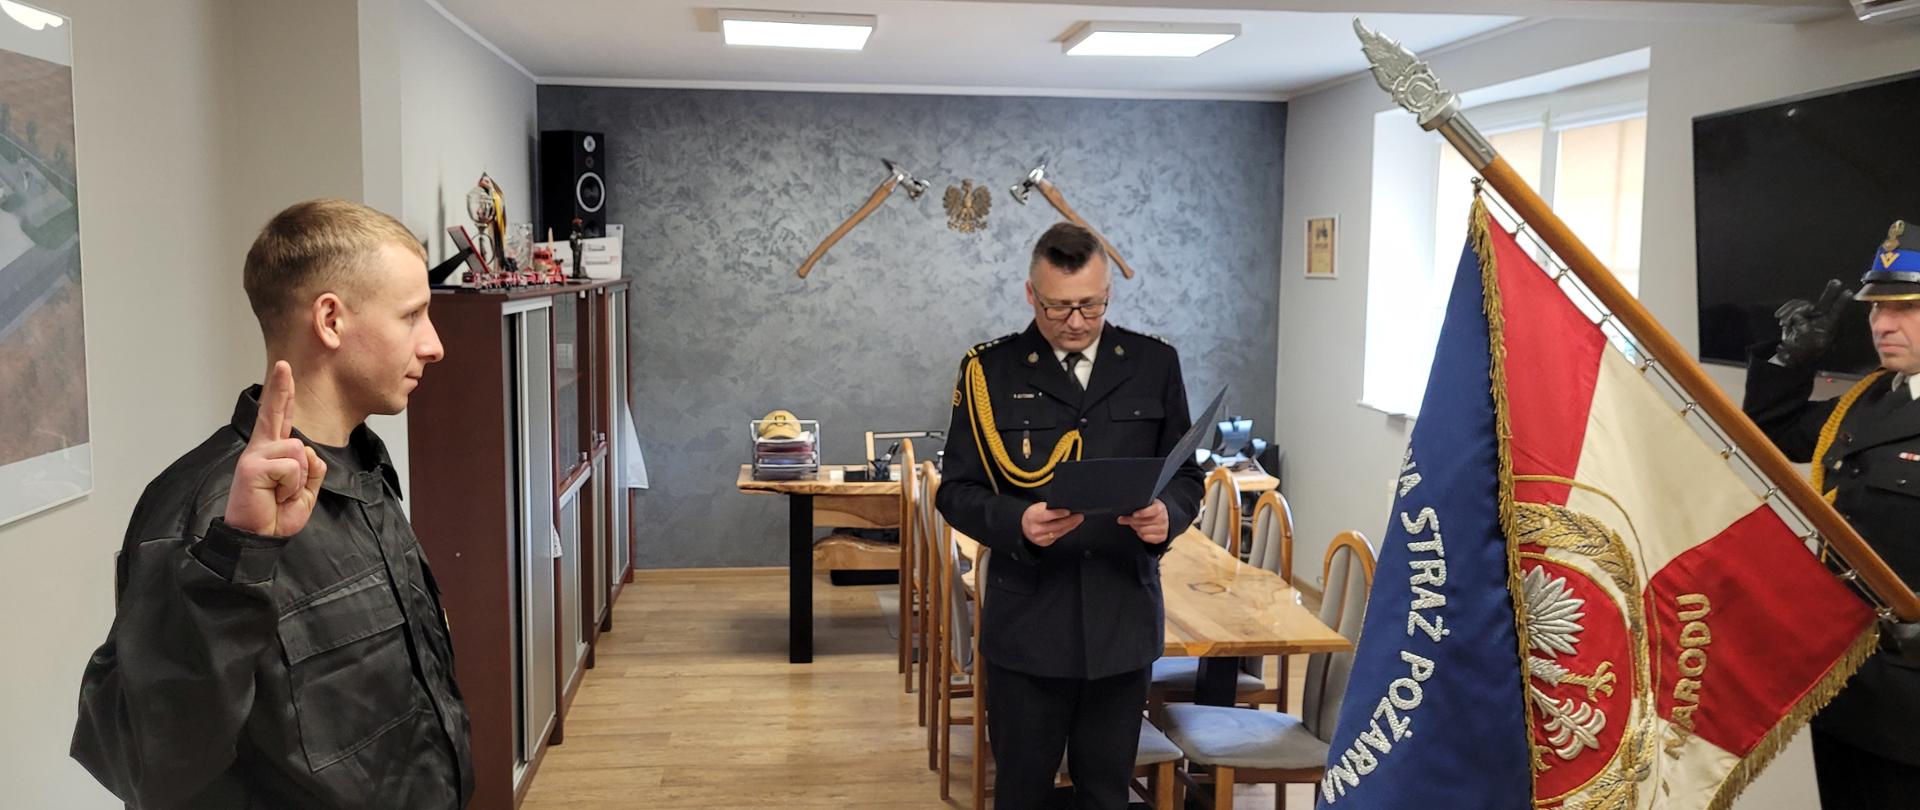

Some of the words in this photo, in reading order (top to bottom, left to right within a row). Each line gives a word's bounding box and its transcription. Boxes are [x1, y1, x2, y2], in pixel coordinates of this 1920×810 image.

[1401, 507, 1450, 642] STRAŻ
[1321, 651, 1435, 804] POŻARNA
[1664, 593, 1711, 760] NARODU
